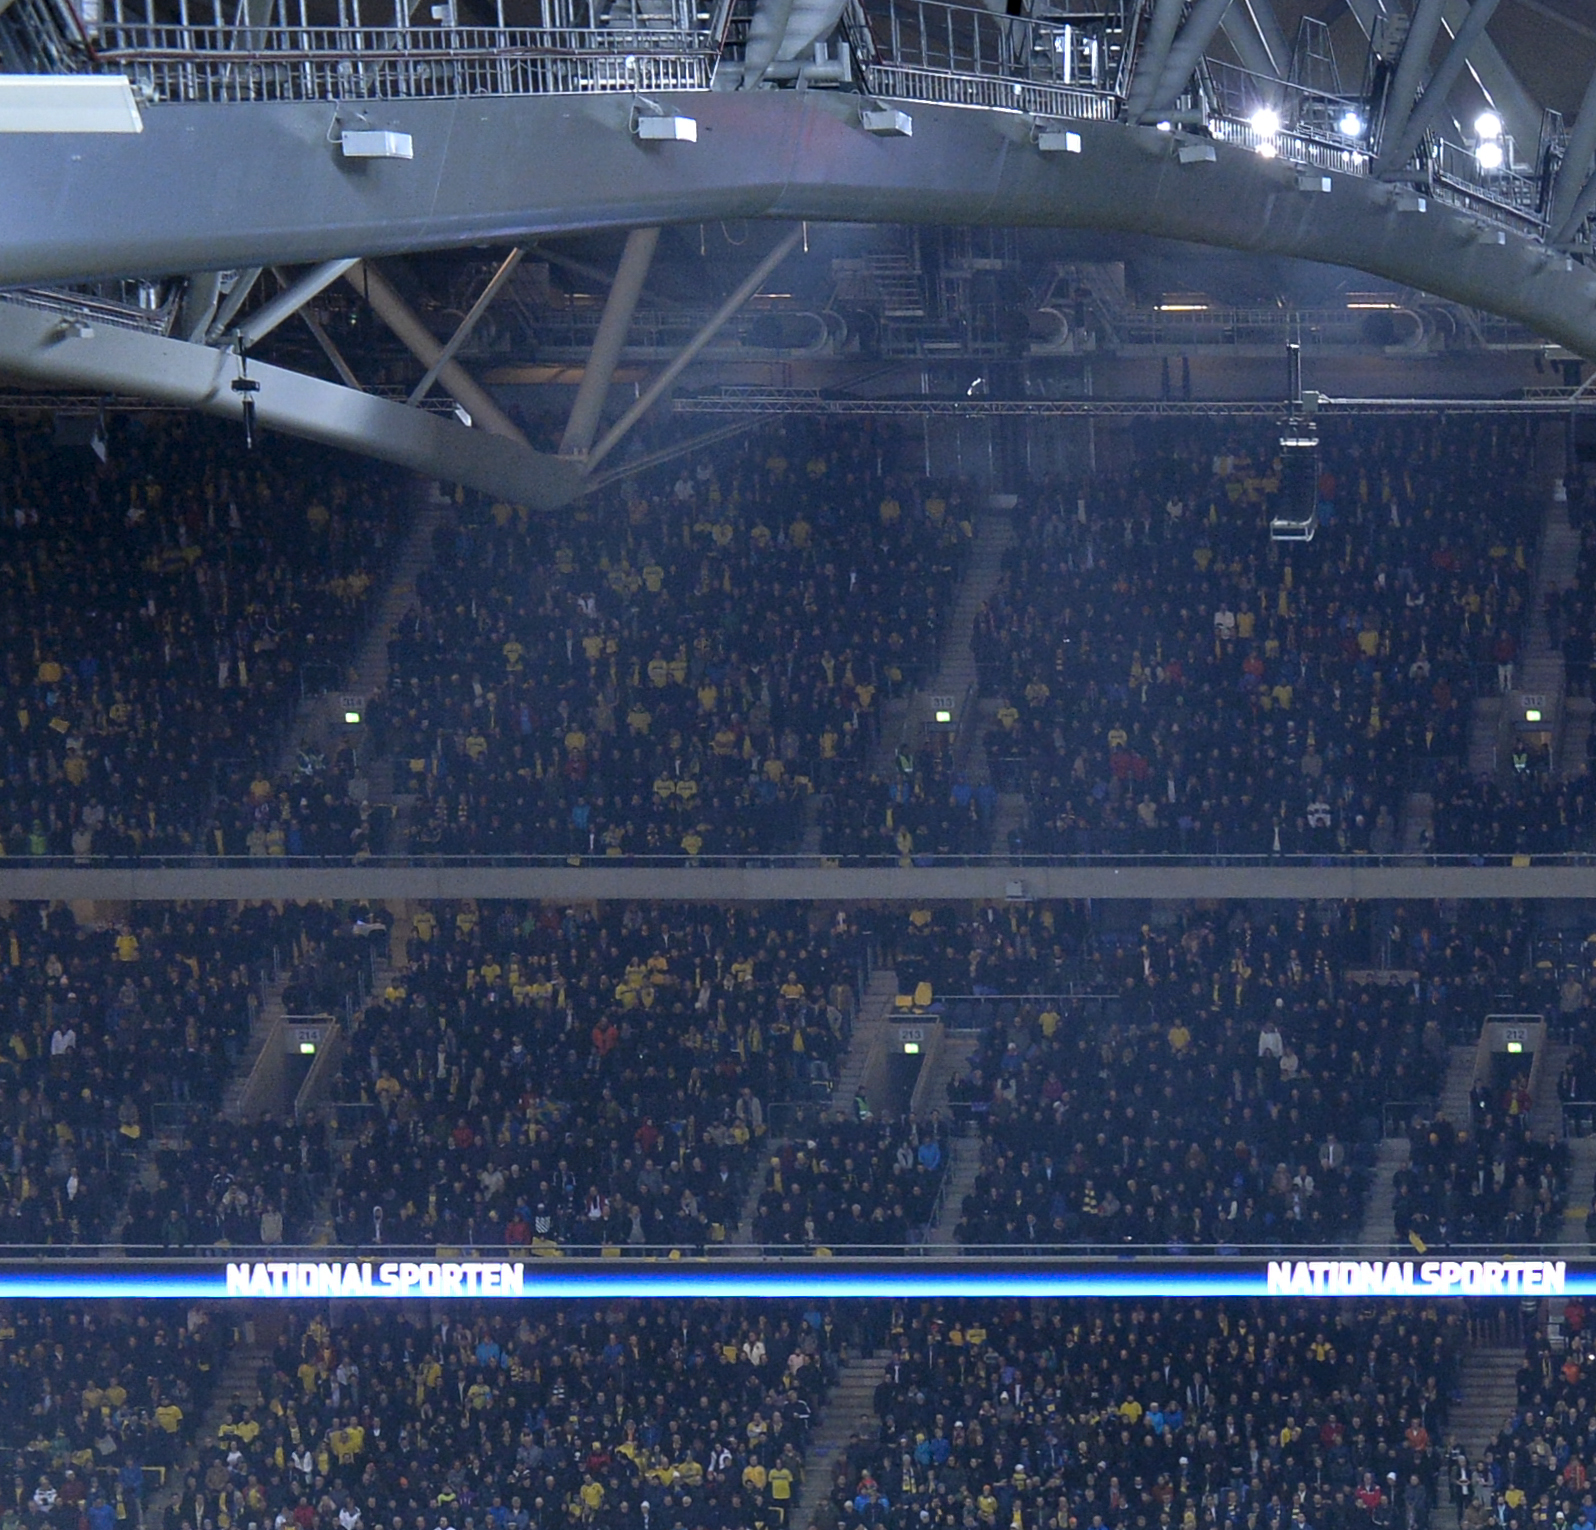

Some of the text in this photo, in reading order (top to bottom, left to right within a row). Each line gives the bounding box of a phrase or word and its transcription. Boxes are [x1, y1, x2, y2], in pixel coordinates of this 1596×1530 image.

[299, 1030, 317, 1040] 214
[902, 1030, 921, 1040] 213
[1506, 1029, 1524, 1039] 212
[226, 1263, 524, 1296] NATIONALSPORTEN
[1267, 1262, 1566, 1295] NATIONALSPORTEN
